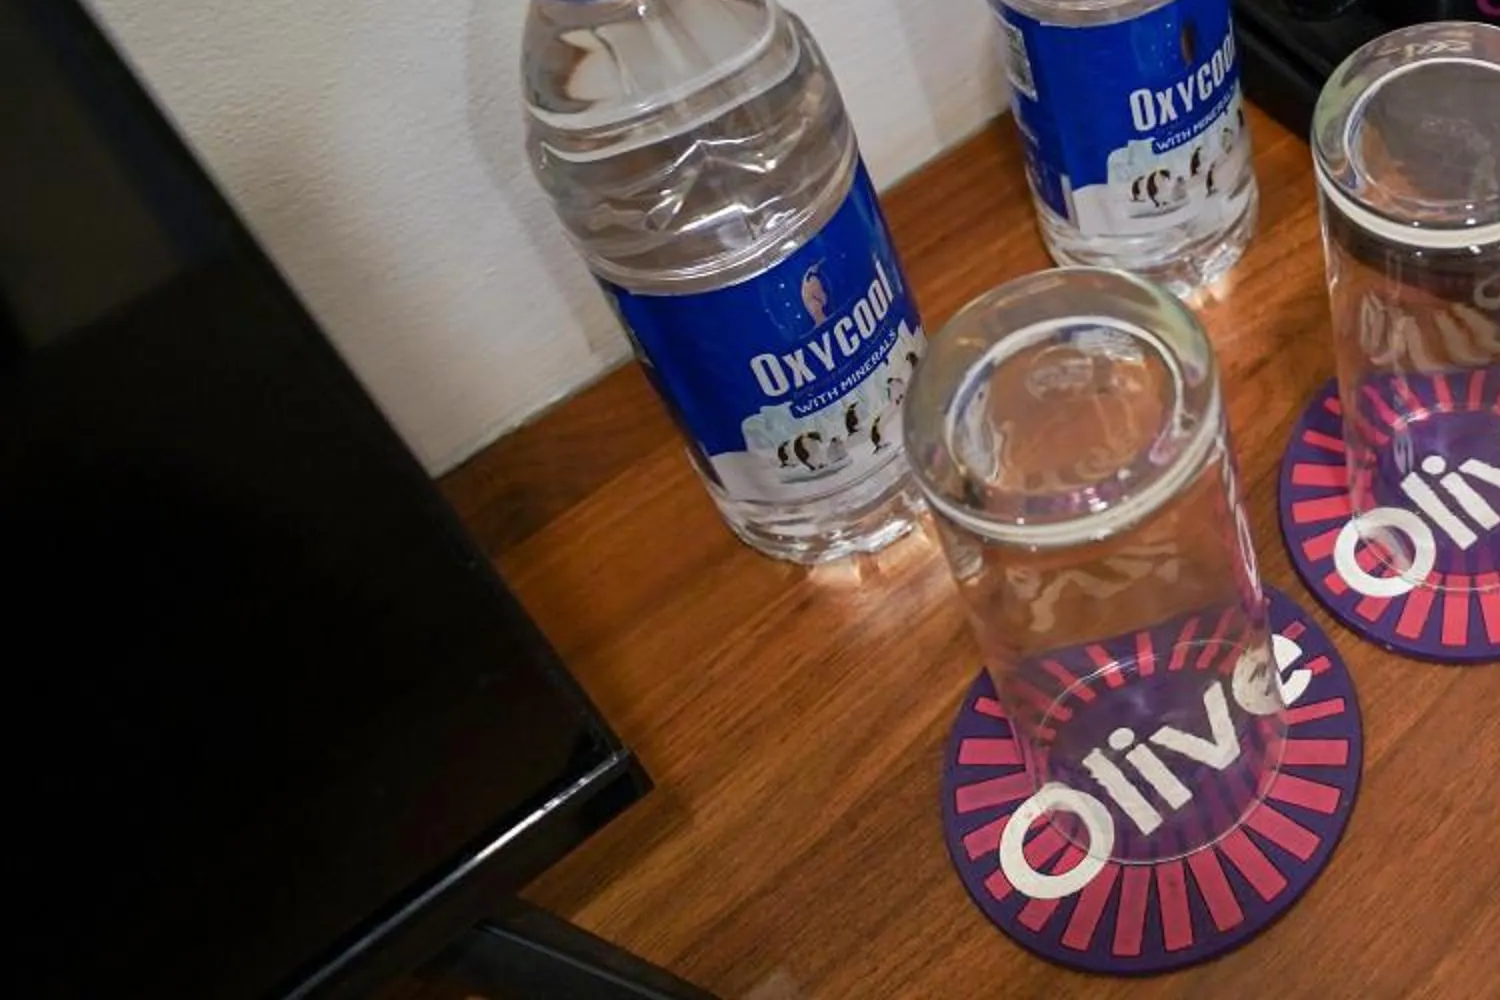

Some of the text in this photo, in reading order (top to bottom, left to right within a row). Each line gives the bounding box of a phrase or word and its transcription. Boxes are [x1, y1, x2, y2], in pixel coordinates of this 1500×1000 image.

[795, 328, 896, 413] WITH MINERALS
[1000, 633, 1313, 899] Olive
